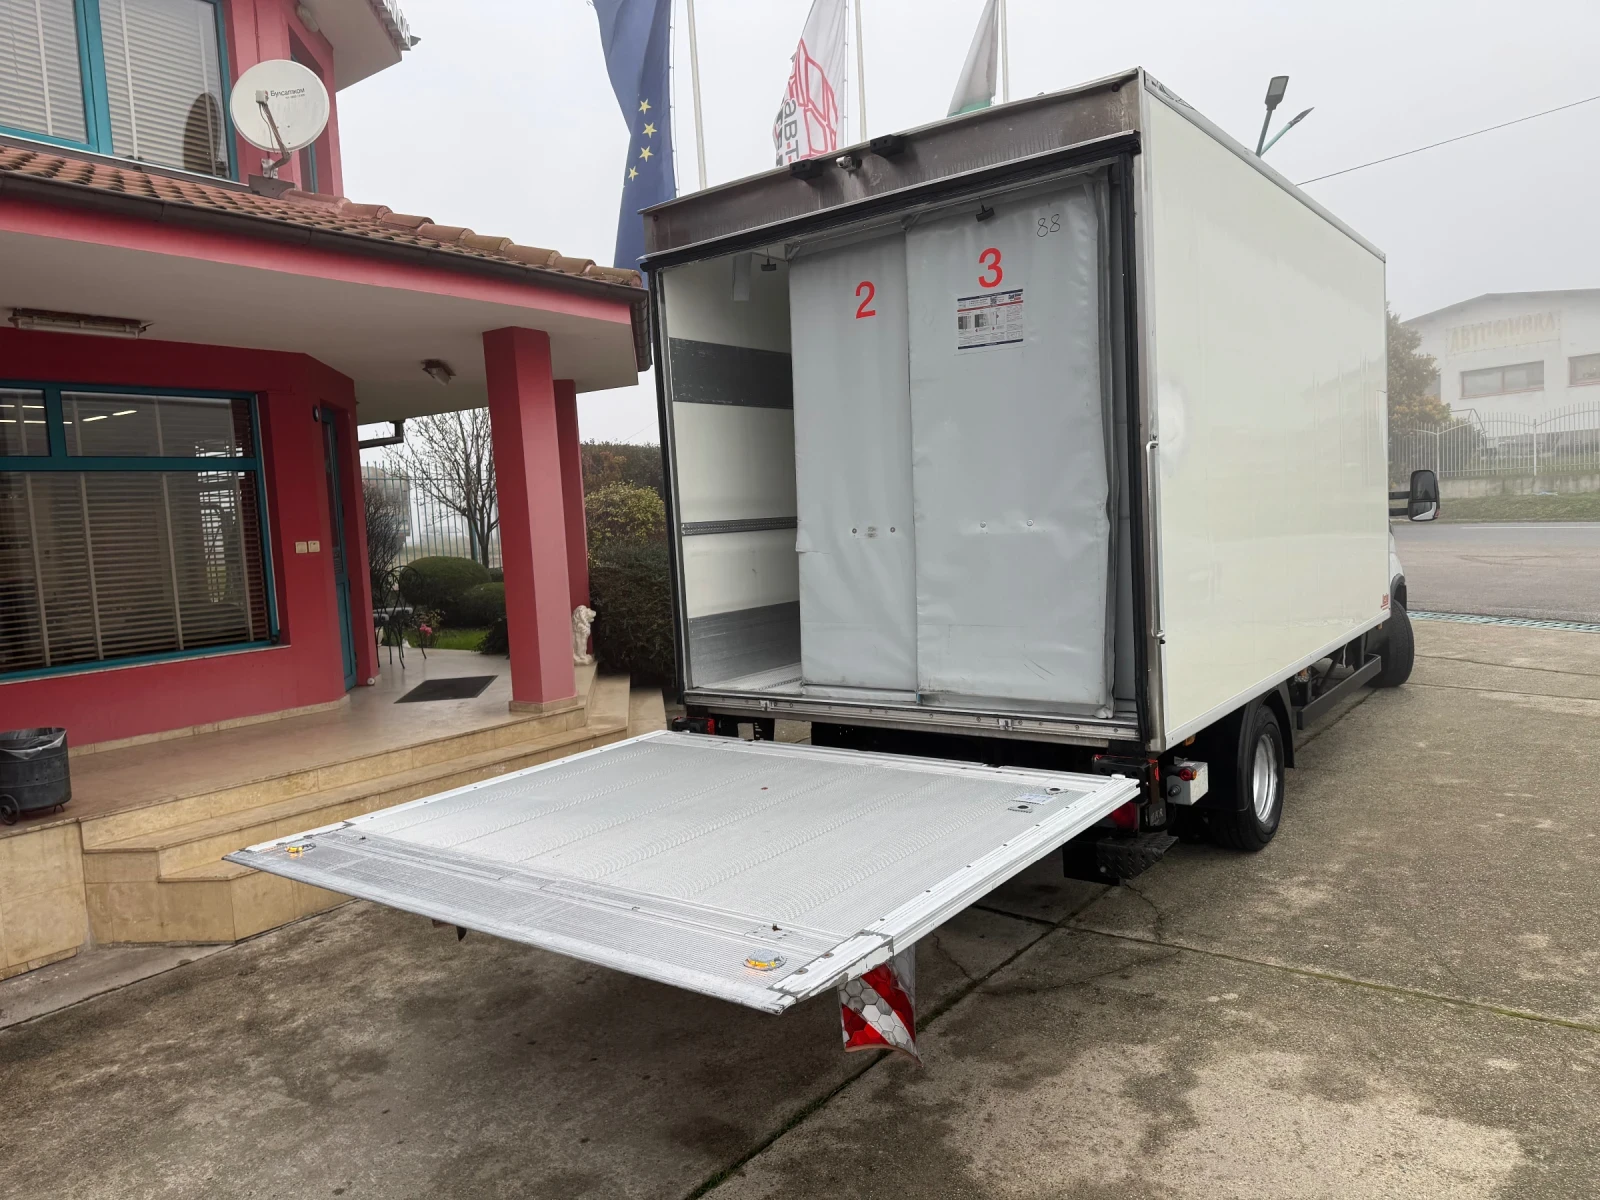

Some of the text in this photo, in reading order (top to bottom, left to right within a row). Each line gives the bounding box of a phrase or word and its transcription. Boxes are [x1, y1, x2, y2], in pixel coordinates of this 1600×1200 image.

[1036, 213, 1061, 238] 88
[978, 247, 1004, 289] 3
[855, 280, 876, 319] 2
